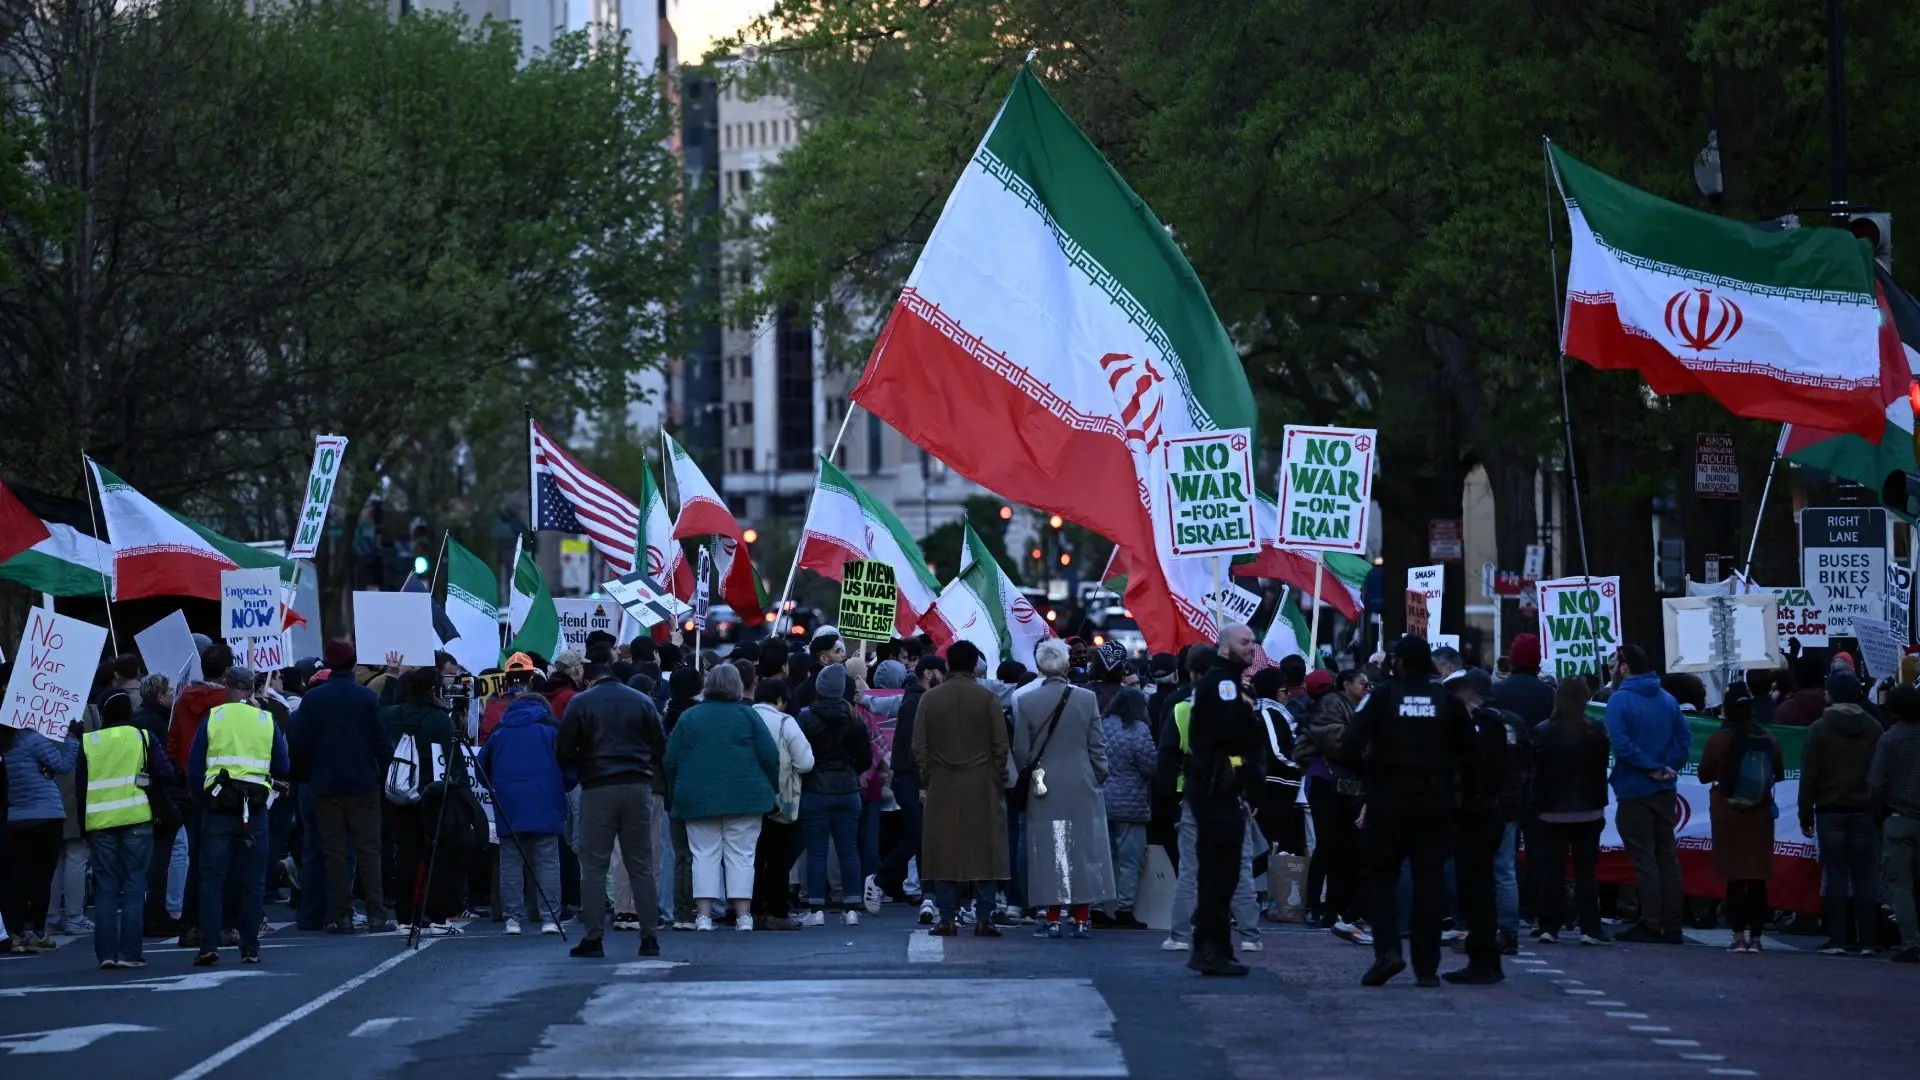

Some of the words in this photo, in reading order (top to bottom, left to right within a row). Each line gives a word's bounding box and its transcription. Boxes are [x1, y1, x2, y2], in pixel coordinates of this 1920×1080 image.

[1182, 443, 1229, 472] NO
[1305, 439, 1351, 467] NO
[1701, 455, 1736, 465] ROUTE
[1170, 472, 1248, 502] WAR
[1290, 463, 1361, 503] WAR
[1706, 474, 1730, 482] DURING
[1177, 518, 1250, 545] ISRAEL
[1291, 511, 1350, 540] IRAN
[1828, 516, 1860, 527] RIGHT
[1830, 532, 1859, 542] LANE
[1820, 554, 1870, 568] BUSES
[845, 561, 864, 581] NO
[866, 561, 895, 584] NEW
[1415, 571, 1435, 579] SMASH
[1820, 571, 1870, 584] BIKES
[1887, 565, 1910, 590] NO
[225, 583, 272, 600] Impeach
[844, 581, 862, 596] US
[863, 583, 896, 600] WAR
[1426, 590, 1440, 599] OLY!
[244, 600, 267, 608] him
[841, 599, 859, 612] IN
[860, 601, 894, 617] THE
[1408, 605, 1425, 618] WAR
[1558, 590, 1600, 615] NO
[1829, 604, 1867, 613] AM-7PM
[232, 607, 275, 628] NOW
[558, 611, 588, 628] efend
[592, 617, 610, 629] our
[840, 612, 870, 630] MIDDLE
[871, 616, 893, 632] EAST
[1776, 606, 1795, 620] hts
[1802, 608, 1821, 627] for
[31, 614, 63, 649] No
[1546, 615, 1616, 644] WAR
[1778, 621, 1827, 635] eedom
[31, 645, 65, 673] War
[33, 672, 79, 703] Crimes
[16, 692, 25, 704] in
[31, 695, 69, 722] OUR
[1399, 704, 1436, 718] POLICE
[12, 709, 69, 739] NAMES
